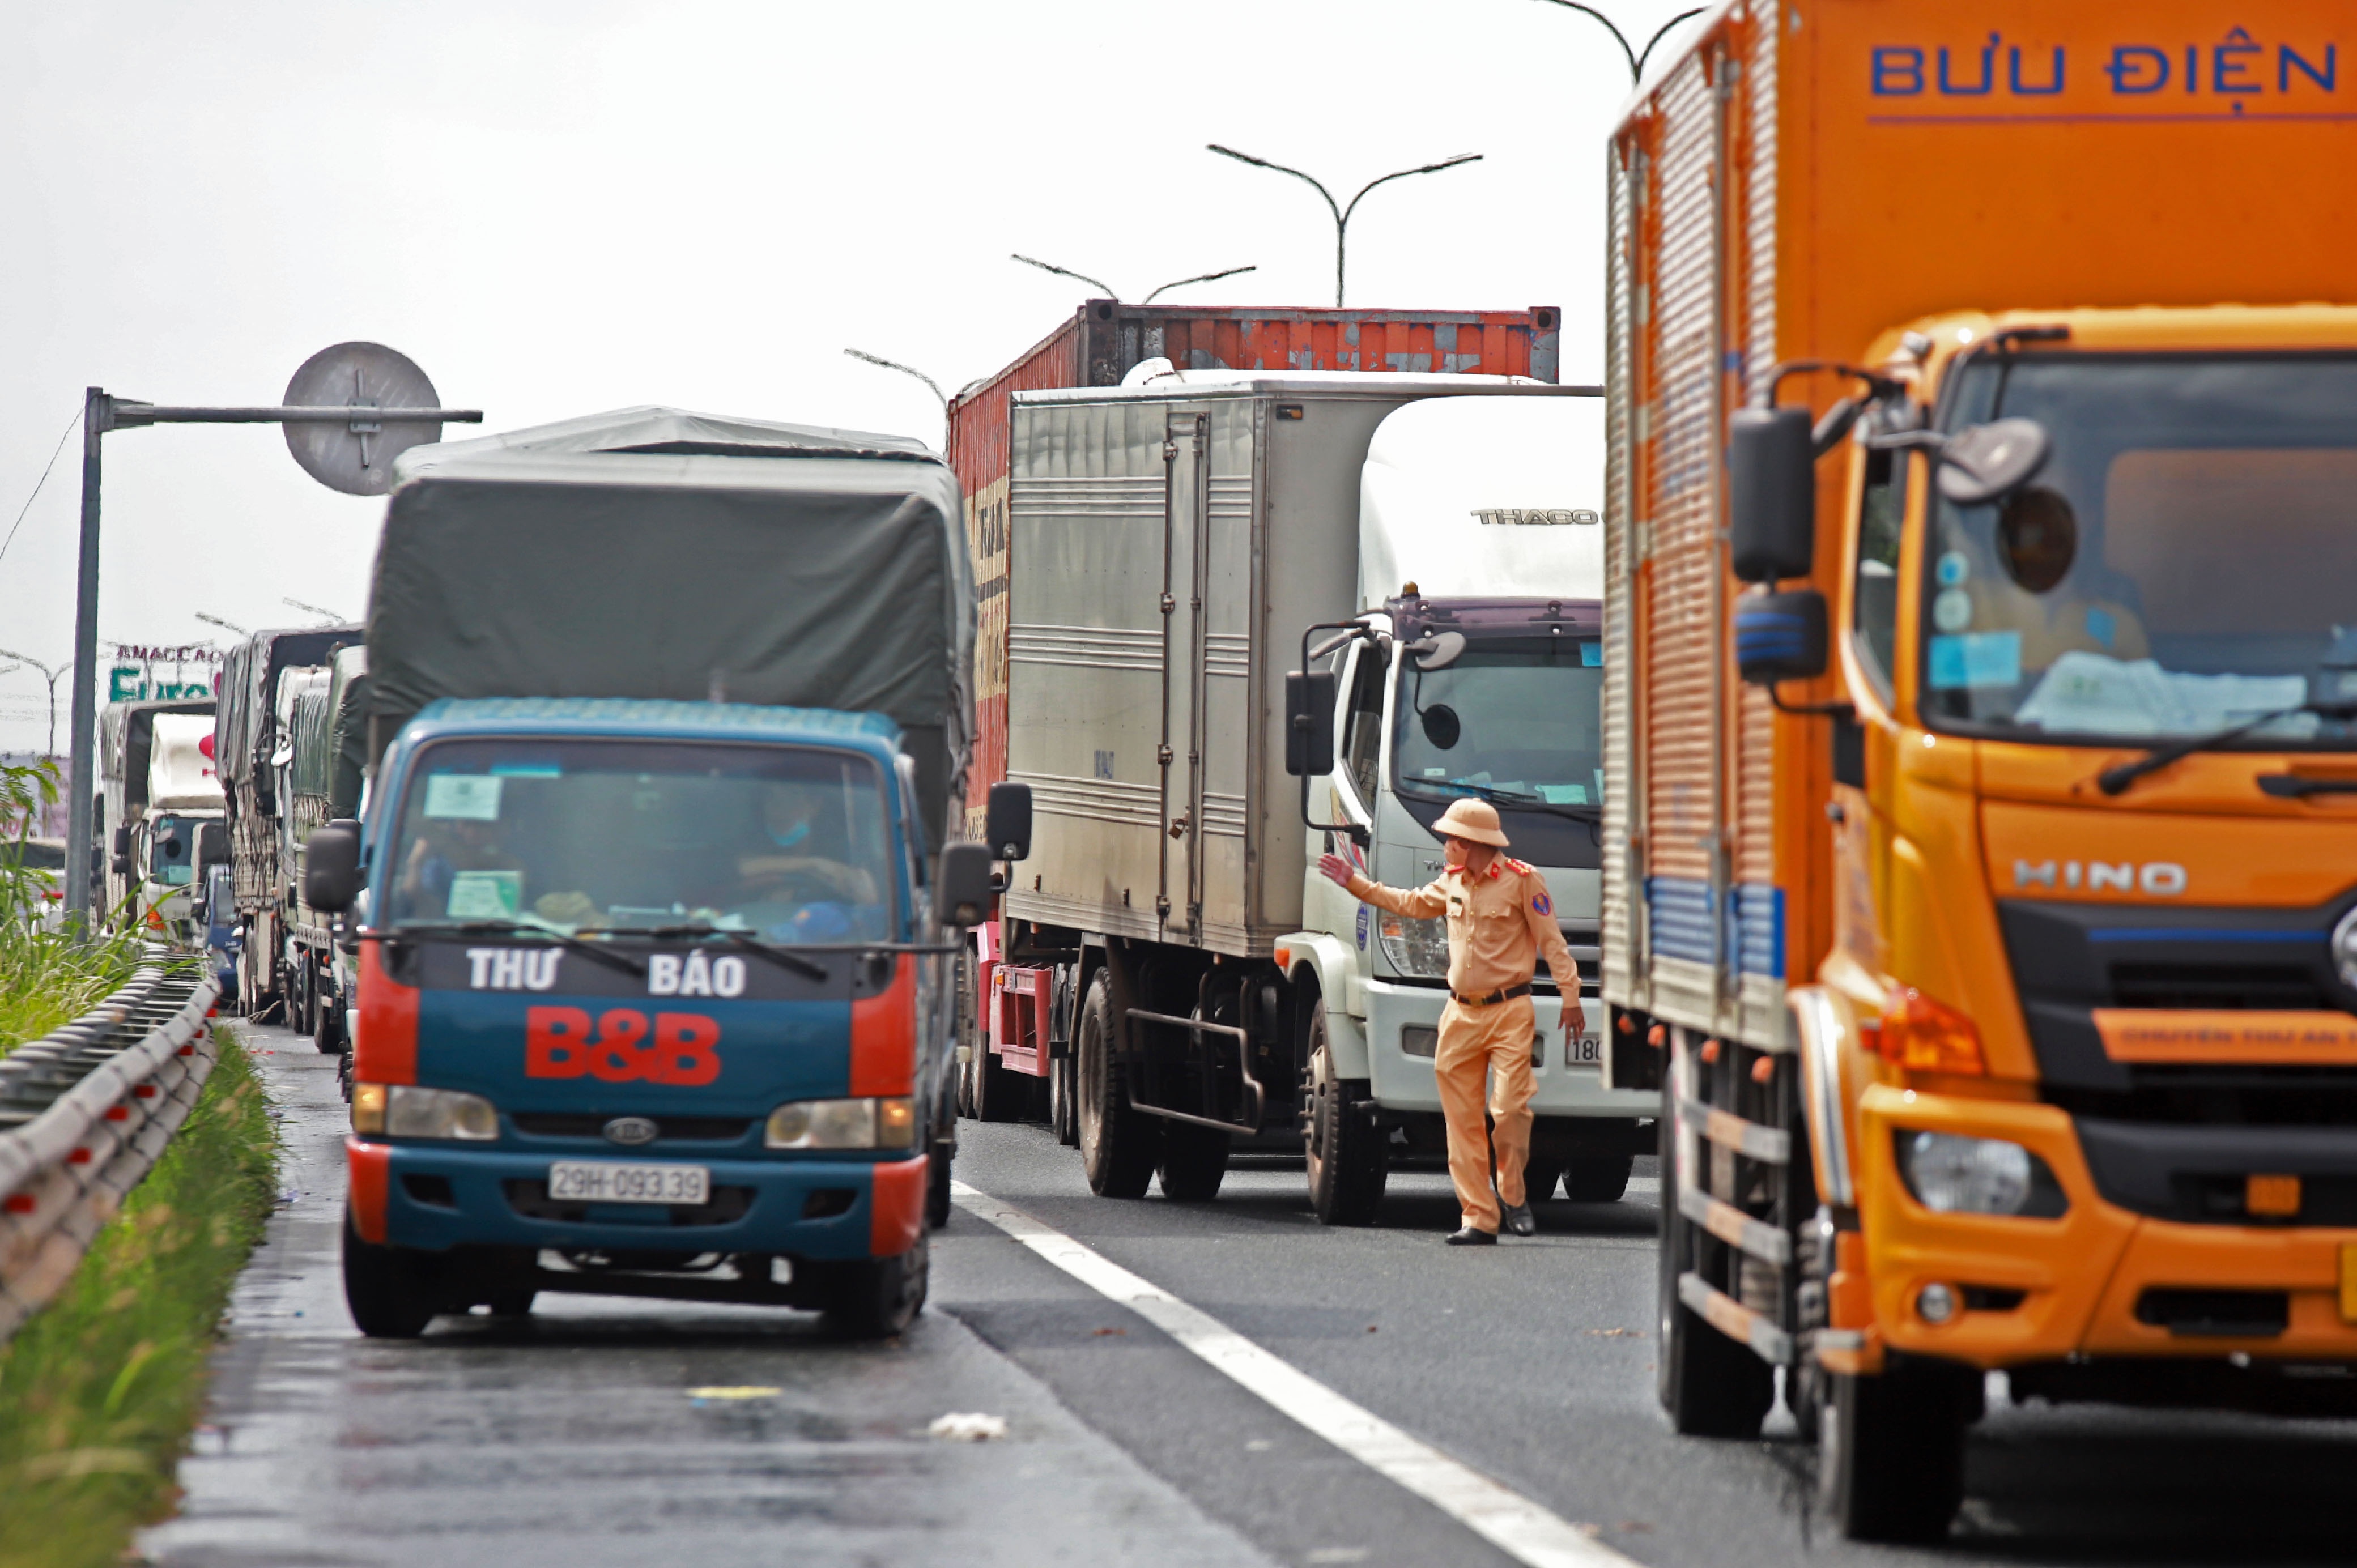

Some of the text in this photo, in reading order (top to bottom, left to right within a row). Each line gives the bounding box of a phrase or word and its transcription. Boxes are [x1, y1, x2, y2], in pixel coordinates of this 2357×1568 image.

[1871, 25, 2336, 114] BƯU ĐIỆN
[1470, 509, 1599, 525] THACO
[2013, 859, 2188, 896] HINO
[466, 947, 746, 998] THƯ BÁO
[526, 1005, 722, 1086] B&B
